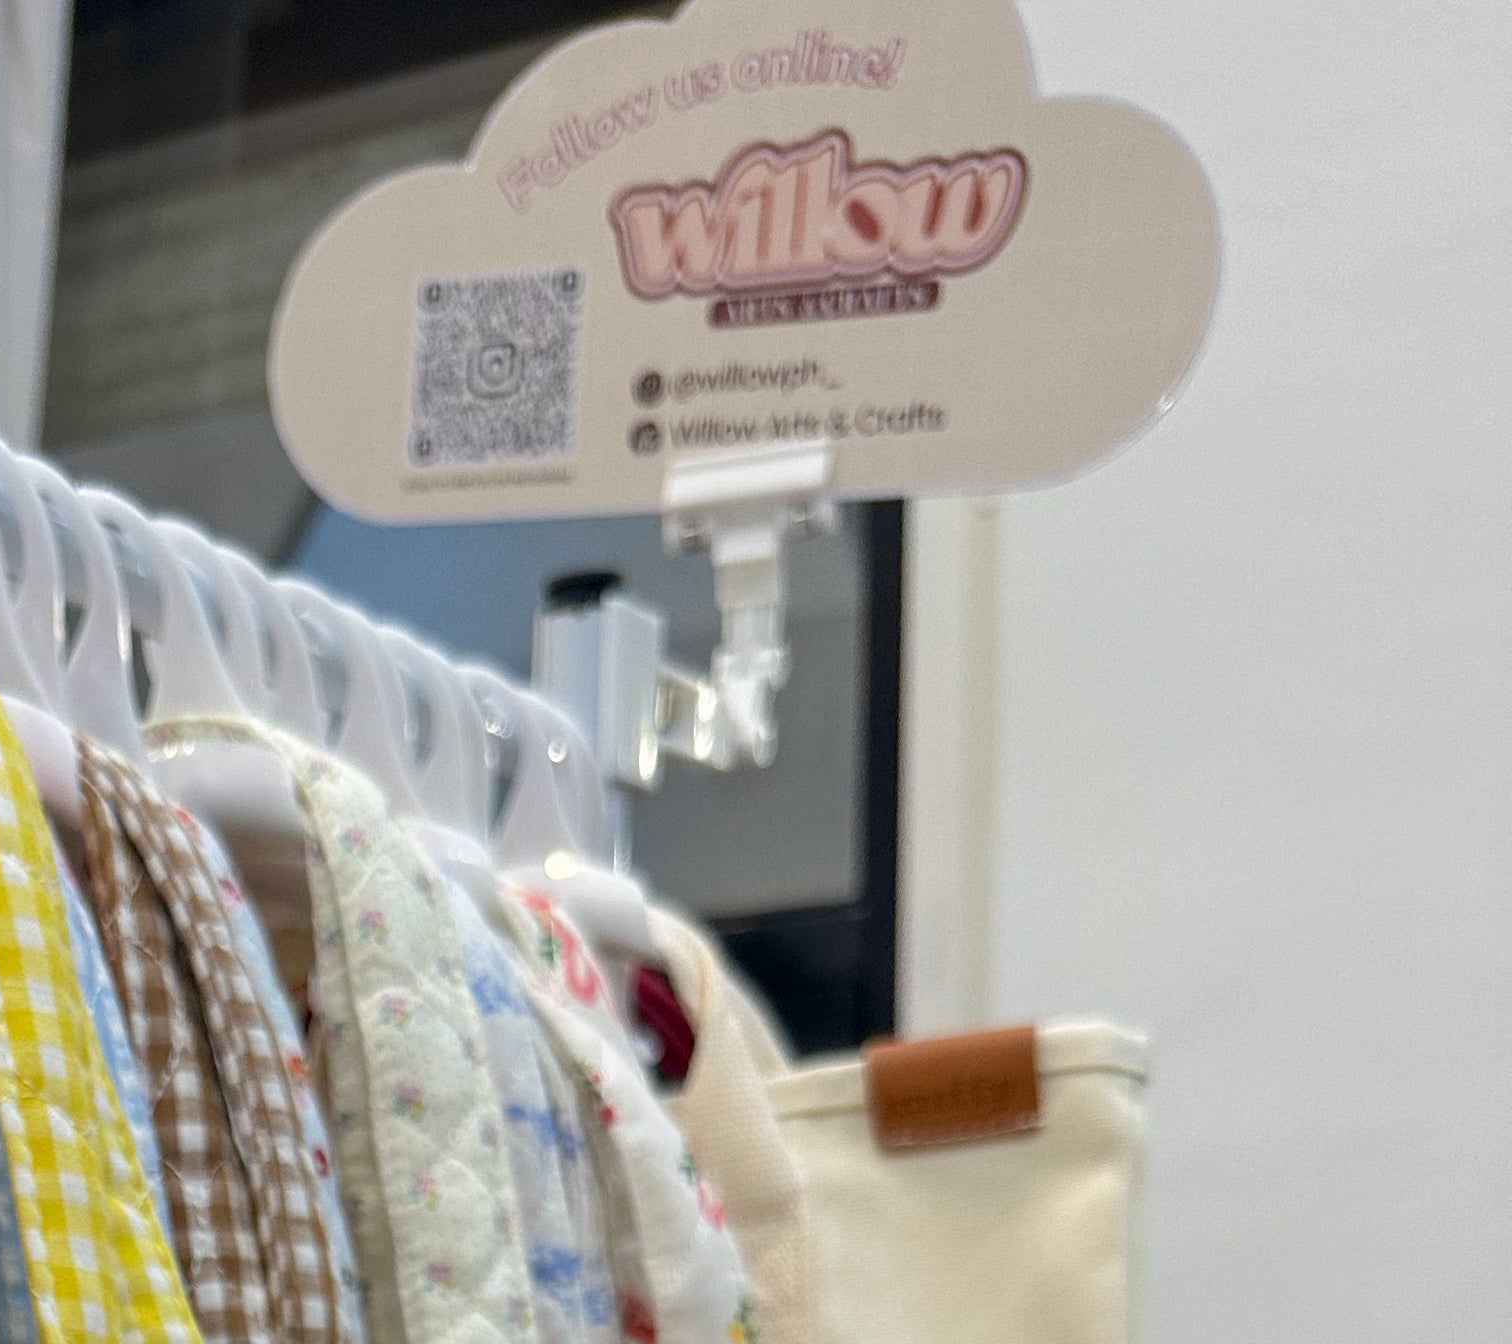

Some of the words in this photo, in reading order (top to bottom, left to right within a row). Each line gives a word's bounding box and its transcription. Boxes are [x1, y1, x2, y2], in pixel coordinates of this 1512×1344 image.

[498, 90, 658, 212] Follow
[663, 63, 726, 109] us
[730, 30, 907, 91] online!
